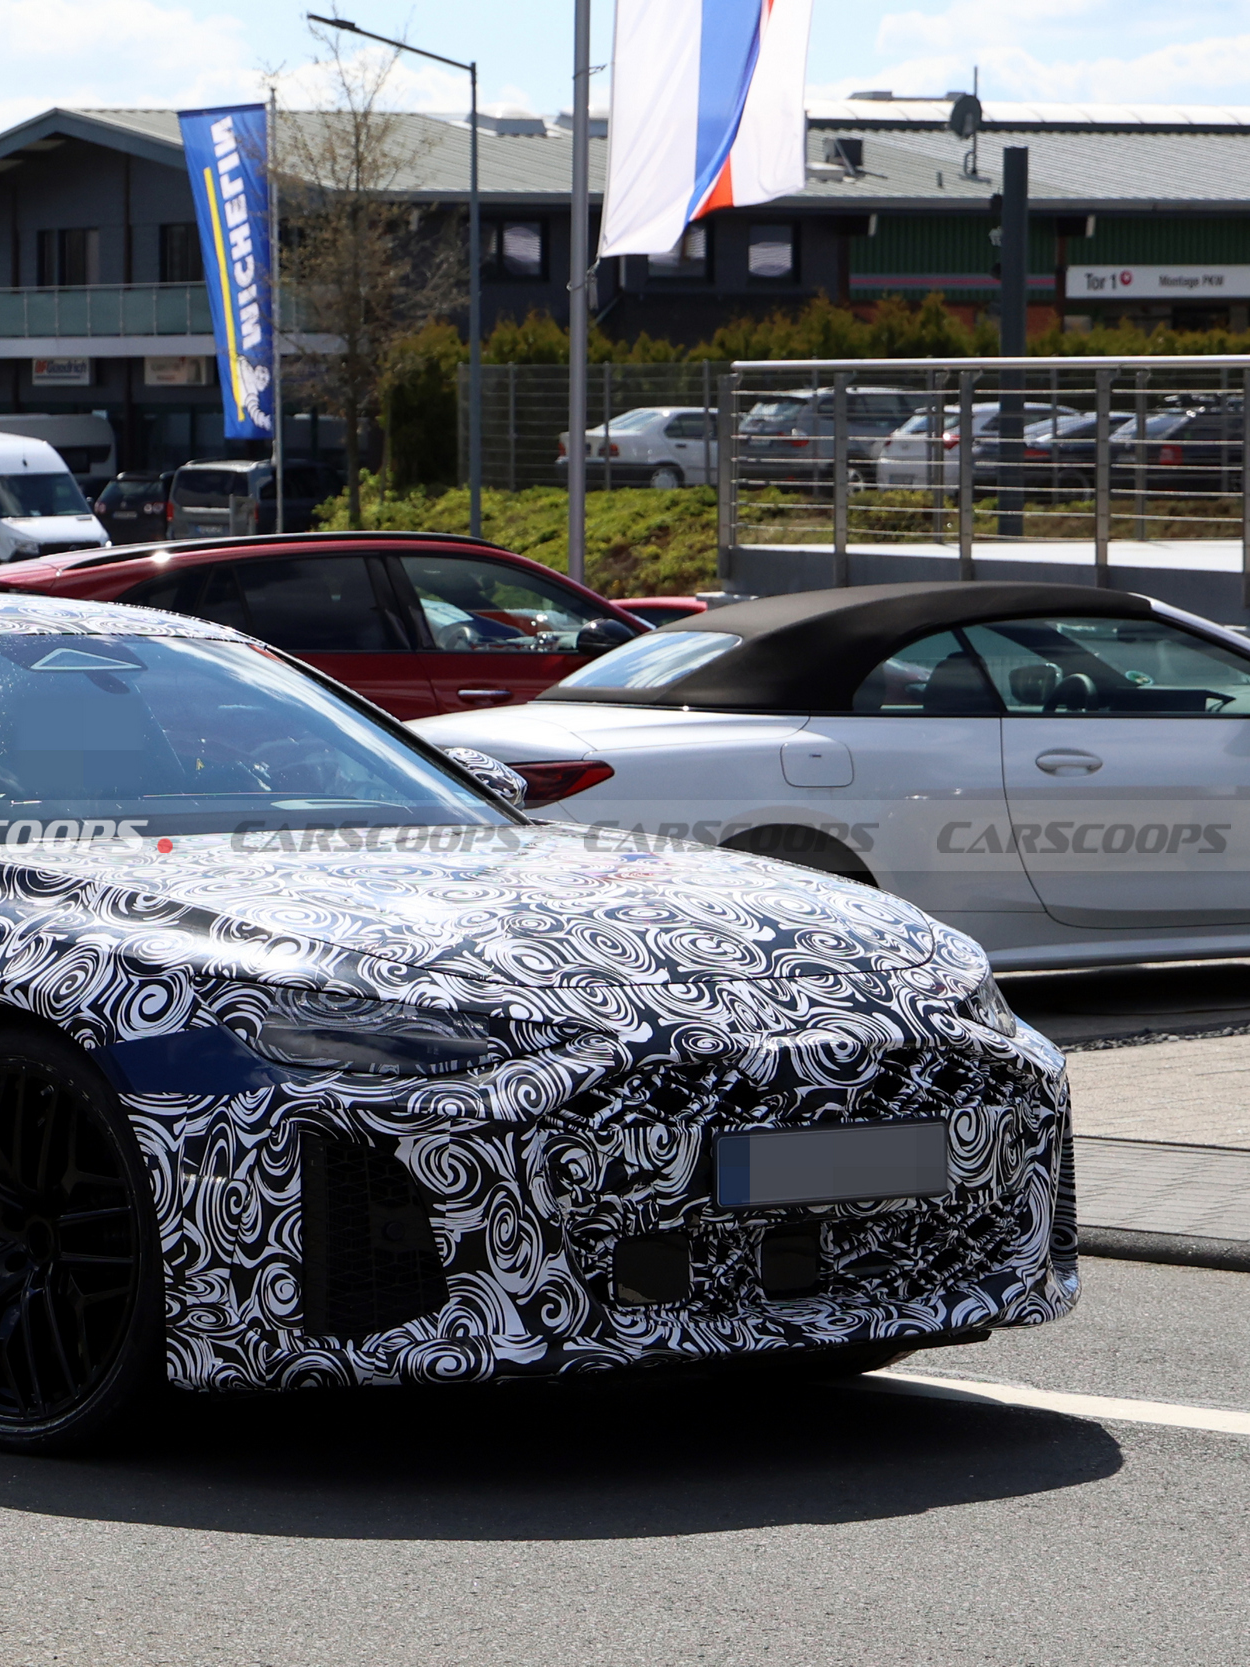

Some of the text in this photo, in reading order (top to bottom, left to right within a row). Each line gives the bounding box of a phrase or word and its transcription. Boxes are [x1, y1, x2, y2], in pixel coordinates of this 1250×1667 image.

[1086, 272, 1118, 290] Tor 1
[1159, 275, 1225, 288] Montage PKW
